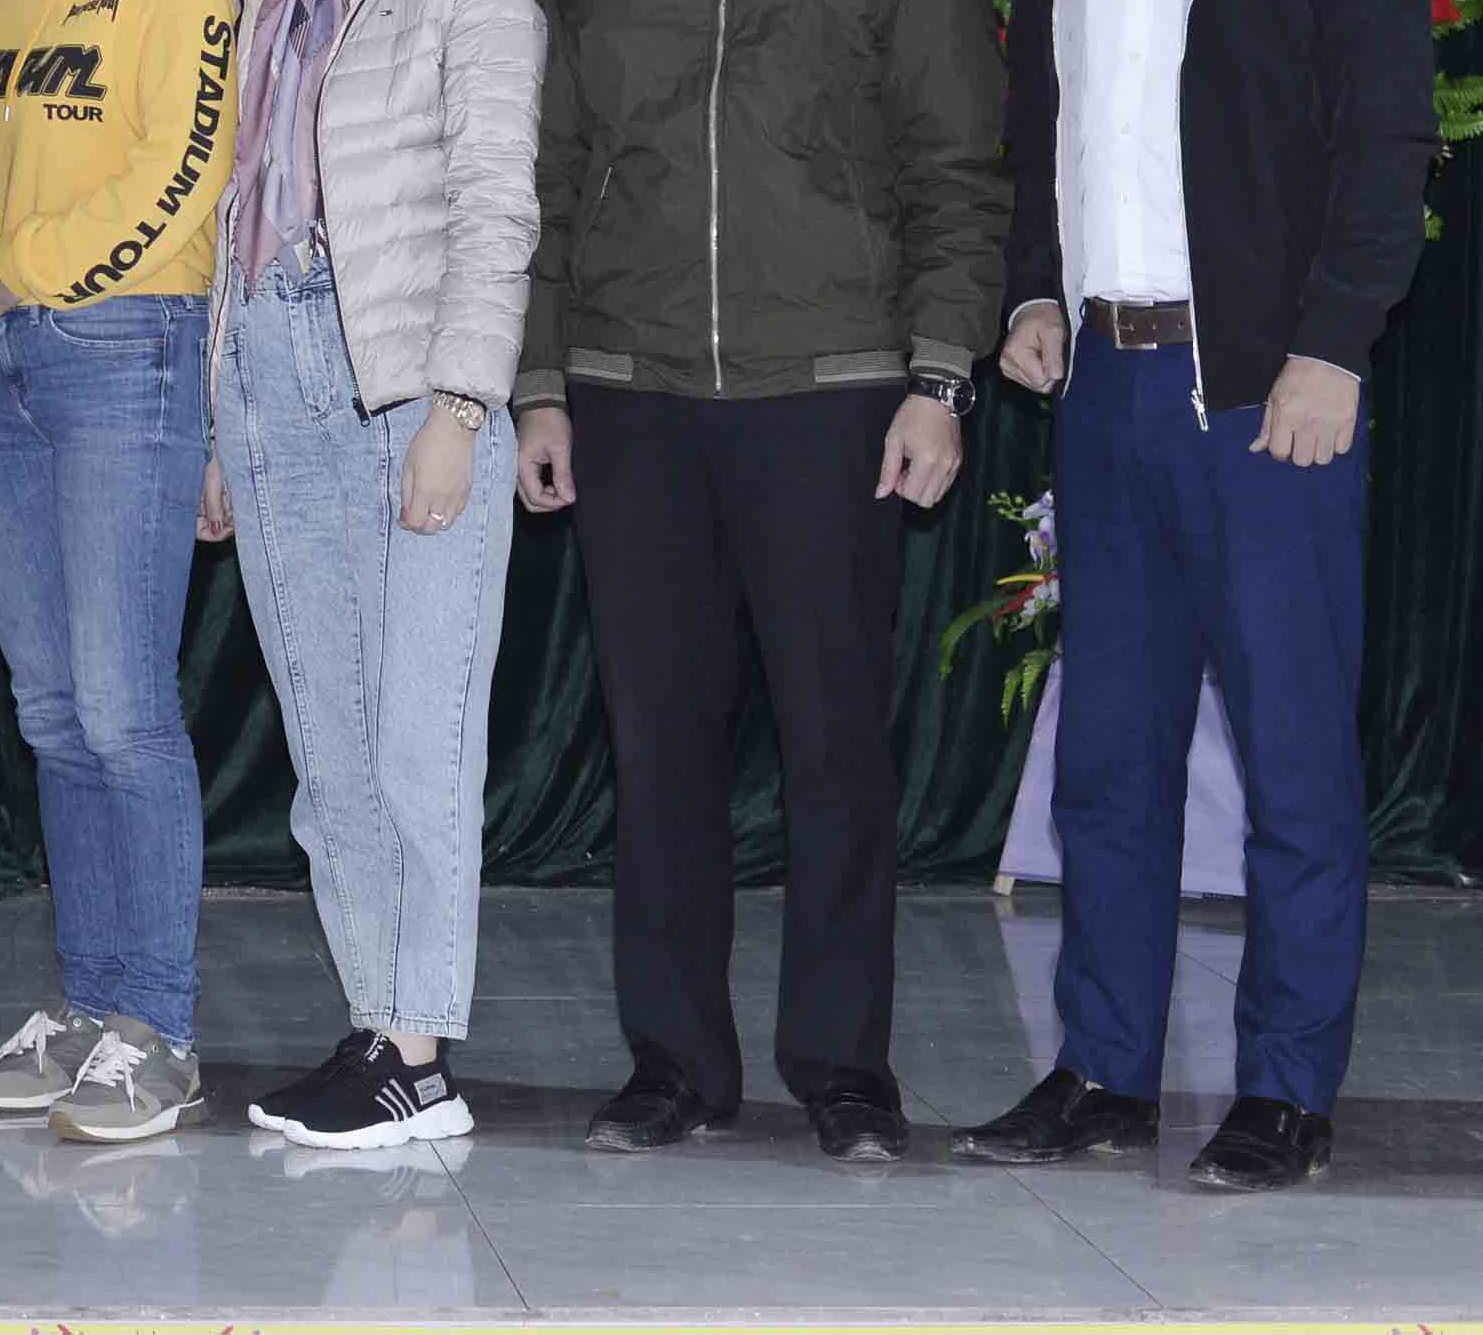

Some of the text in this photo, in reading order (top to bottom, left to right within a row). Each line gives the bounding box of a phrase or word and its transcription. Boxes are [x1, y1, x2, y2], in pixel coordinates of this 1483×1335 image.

[42, 103, 104, 123] TOUR
[53, 14, 232, 305] STADIUM TOUR
